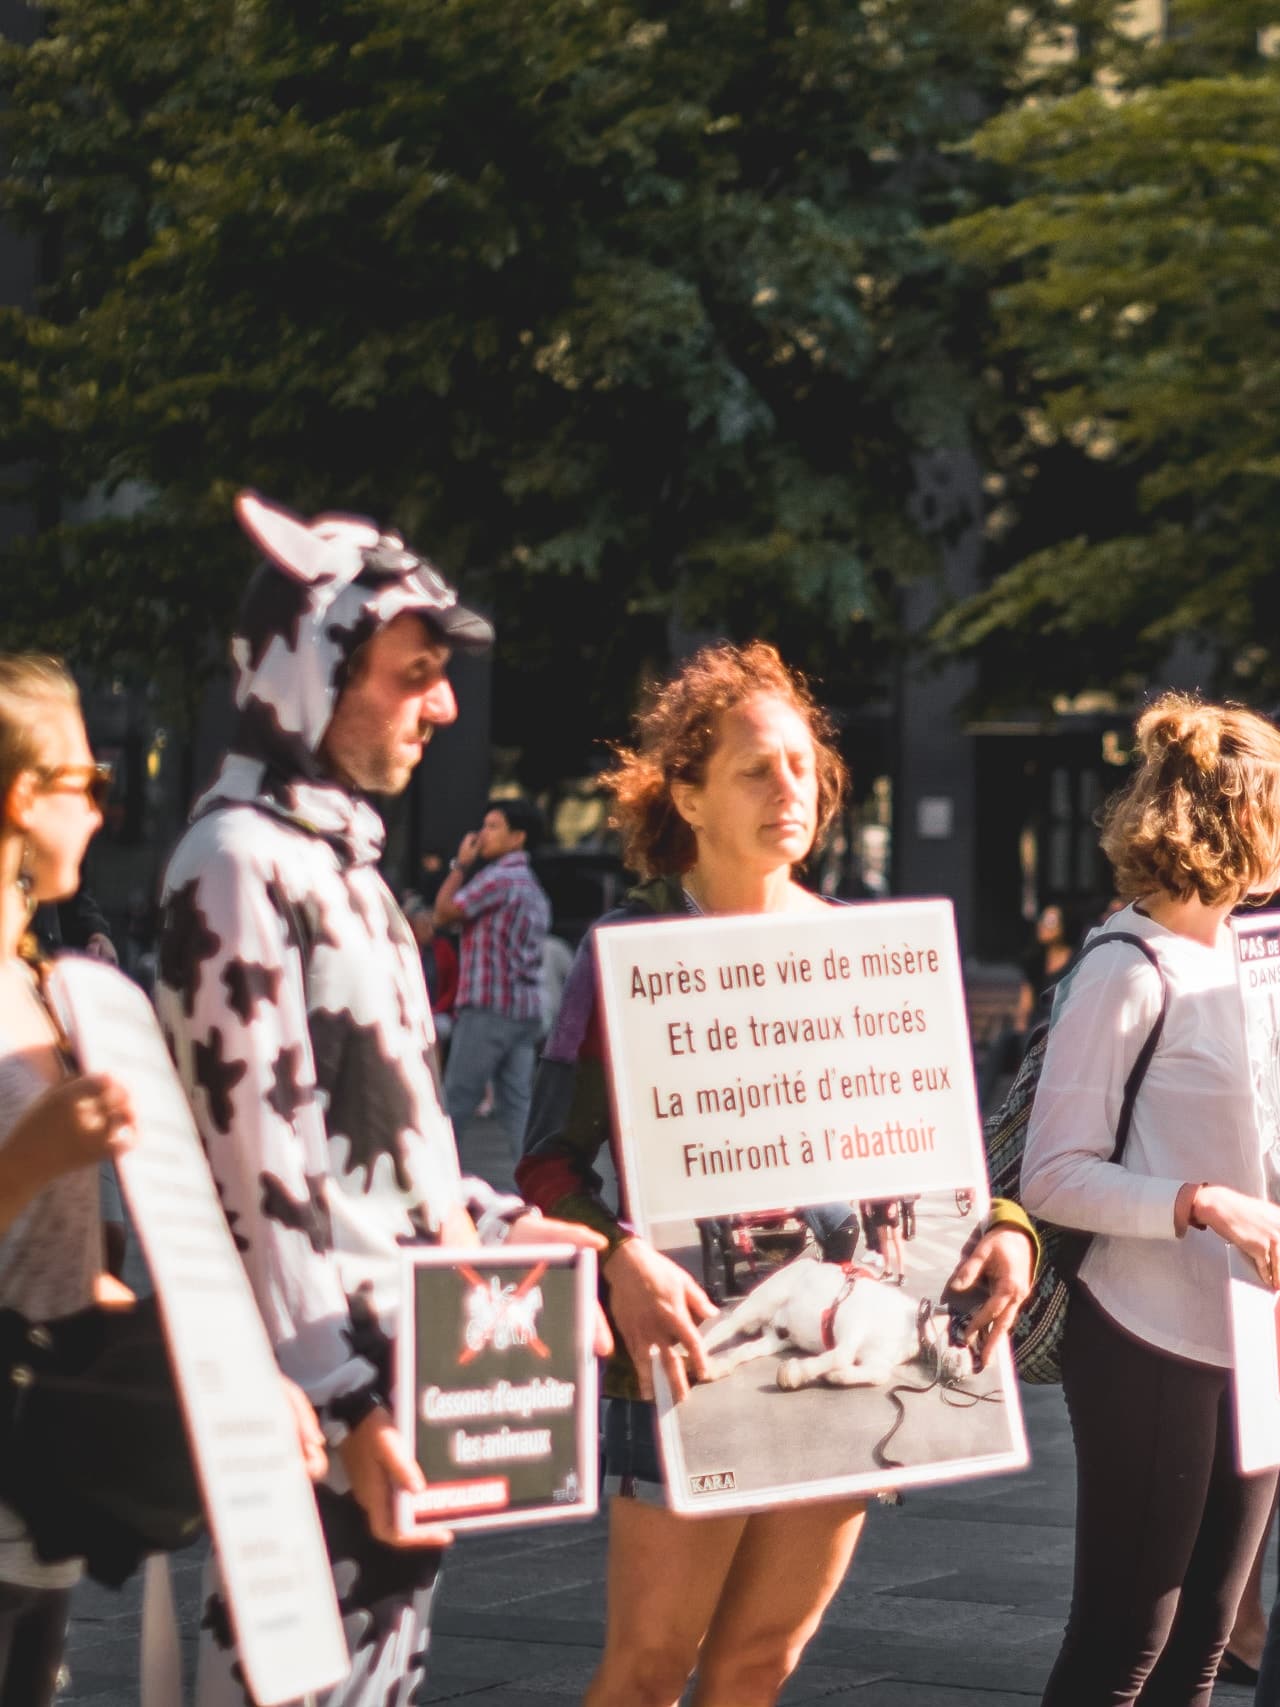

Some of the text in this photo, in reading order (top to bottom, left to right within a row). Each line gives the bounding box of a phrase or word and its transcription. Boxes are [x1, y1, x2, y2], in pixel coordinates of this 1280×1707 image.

[630, 942, 940, 1004] Après une vie de misère
[1239, 936, 1265, 961] PAS
[666, 1000, 927, 1056] Et de travaux forcés
[652, 1065, 952, 1120] La majorité d'entre eux
[682, 1117, 937, 1178] Finiront à l'abattoir
[424, 1377, 575, 1420] Cessons d'exploiter
[455, 1427, 551, 1462] les animaux
[691, 1473, 735, 1493] KARA
